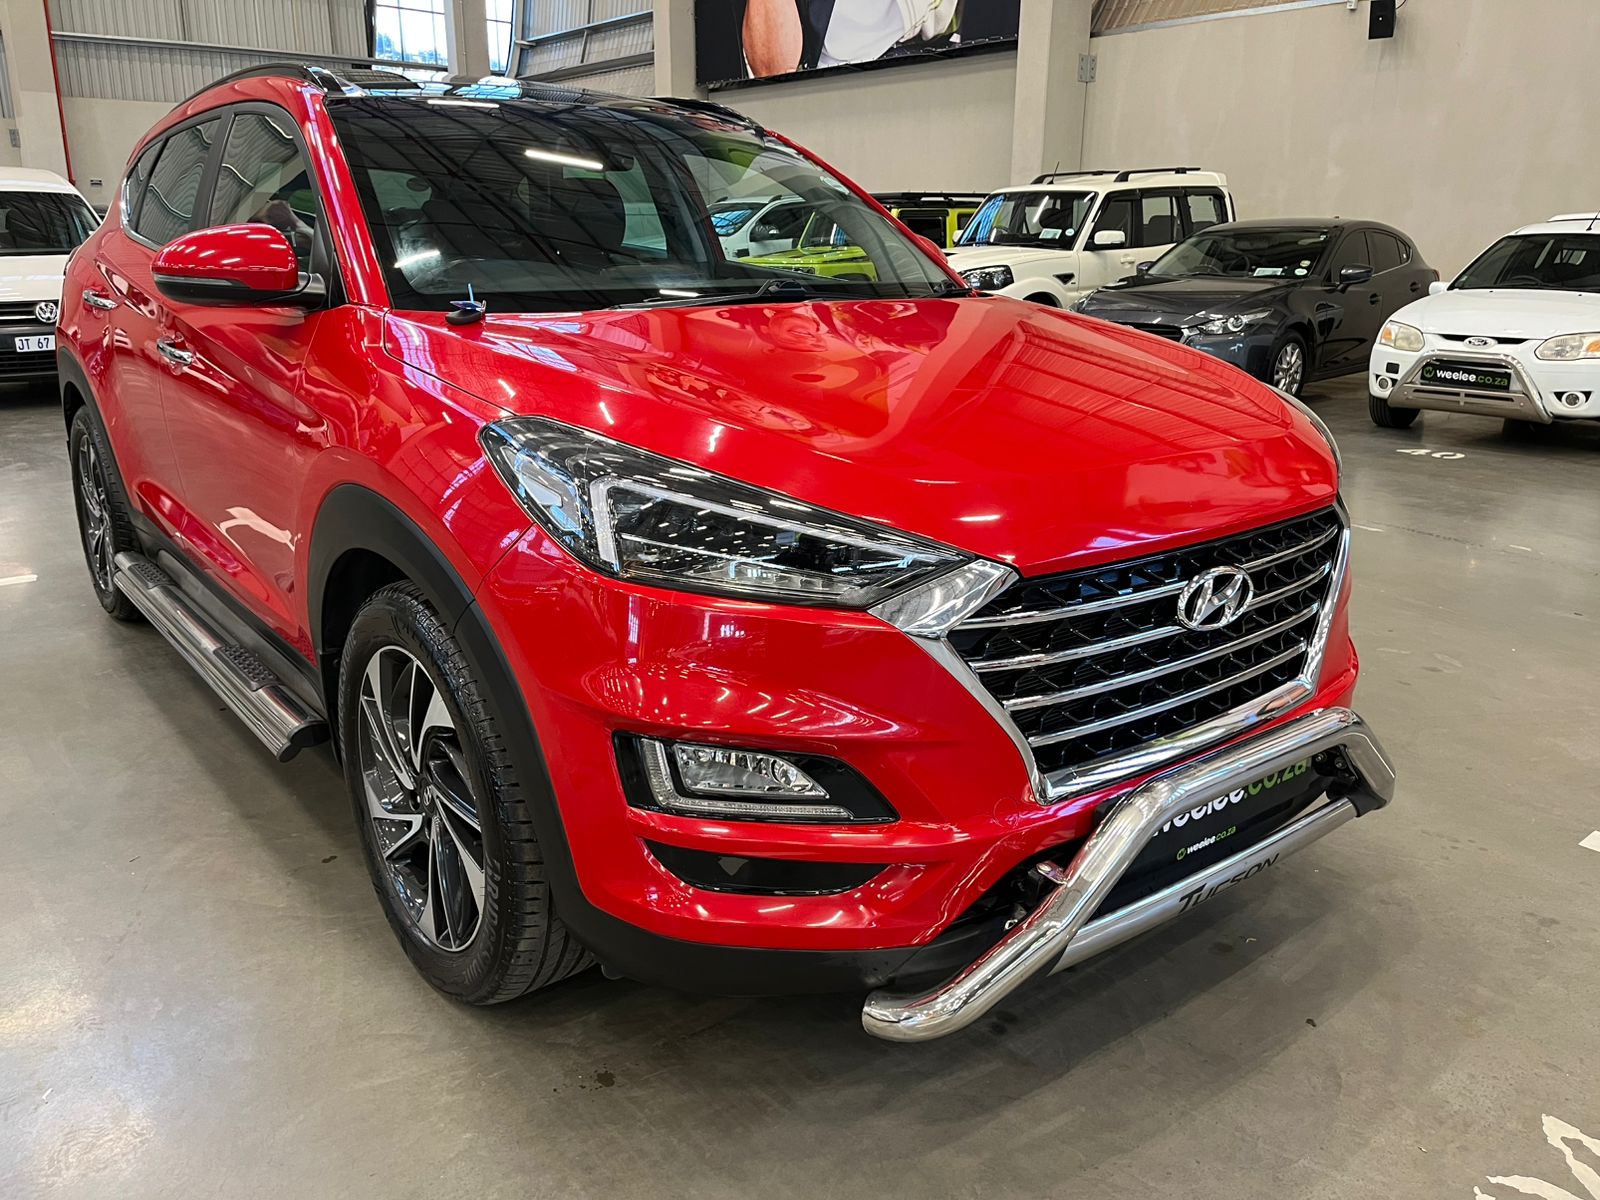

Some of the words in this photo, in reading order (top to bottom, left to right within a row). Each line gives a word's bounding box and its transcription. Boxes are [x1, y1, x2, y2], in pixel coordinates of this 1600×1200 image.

[18, 338, 31, 351] JT
[37, 337, 50, 349] 67
[1436, 369, 1508, 386] weelee.co.za
[1395, 448, 1466, 459] 40
[1187, 825, 1237, 855] weelee.co.za
